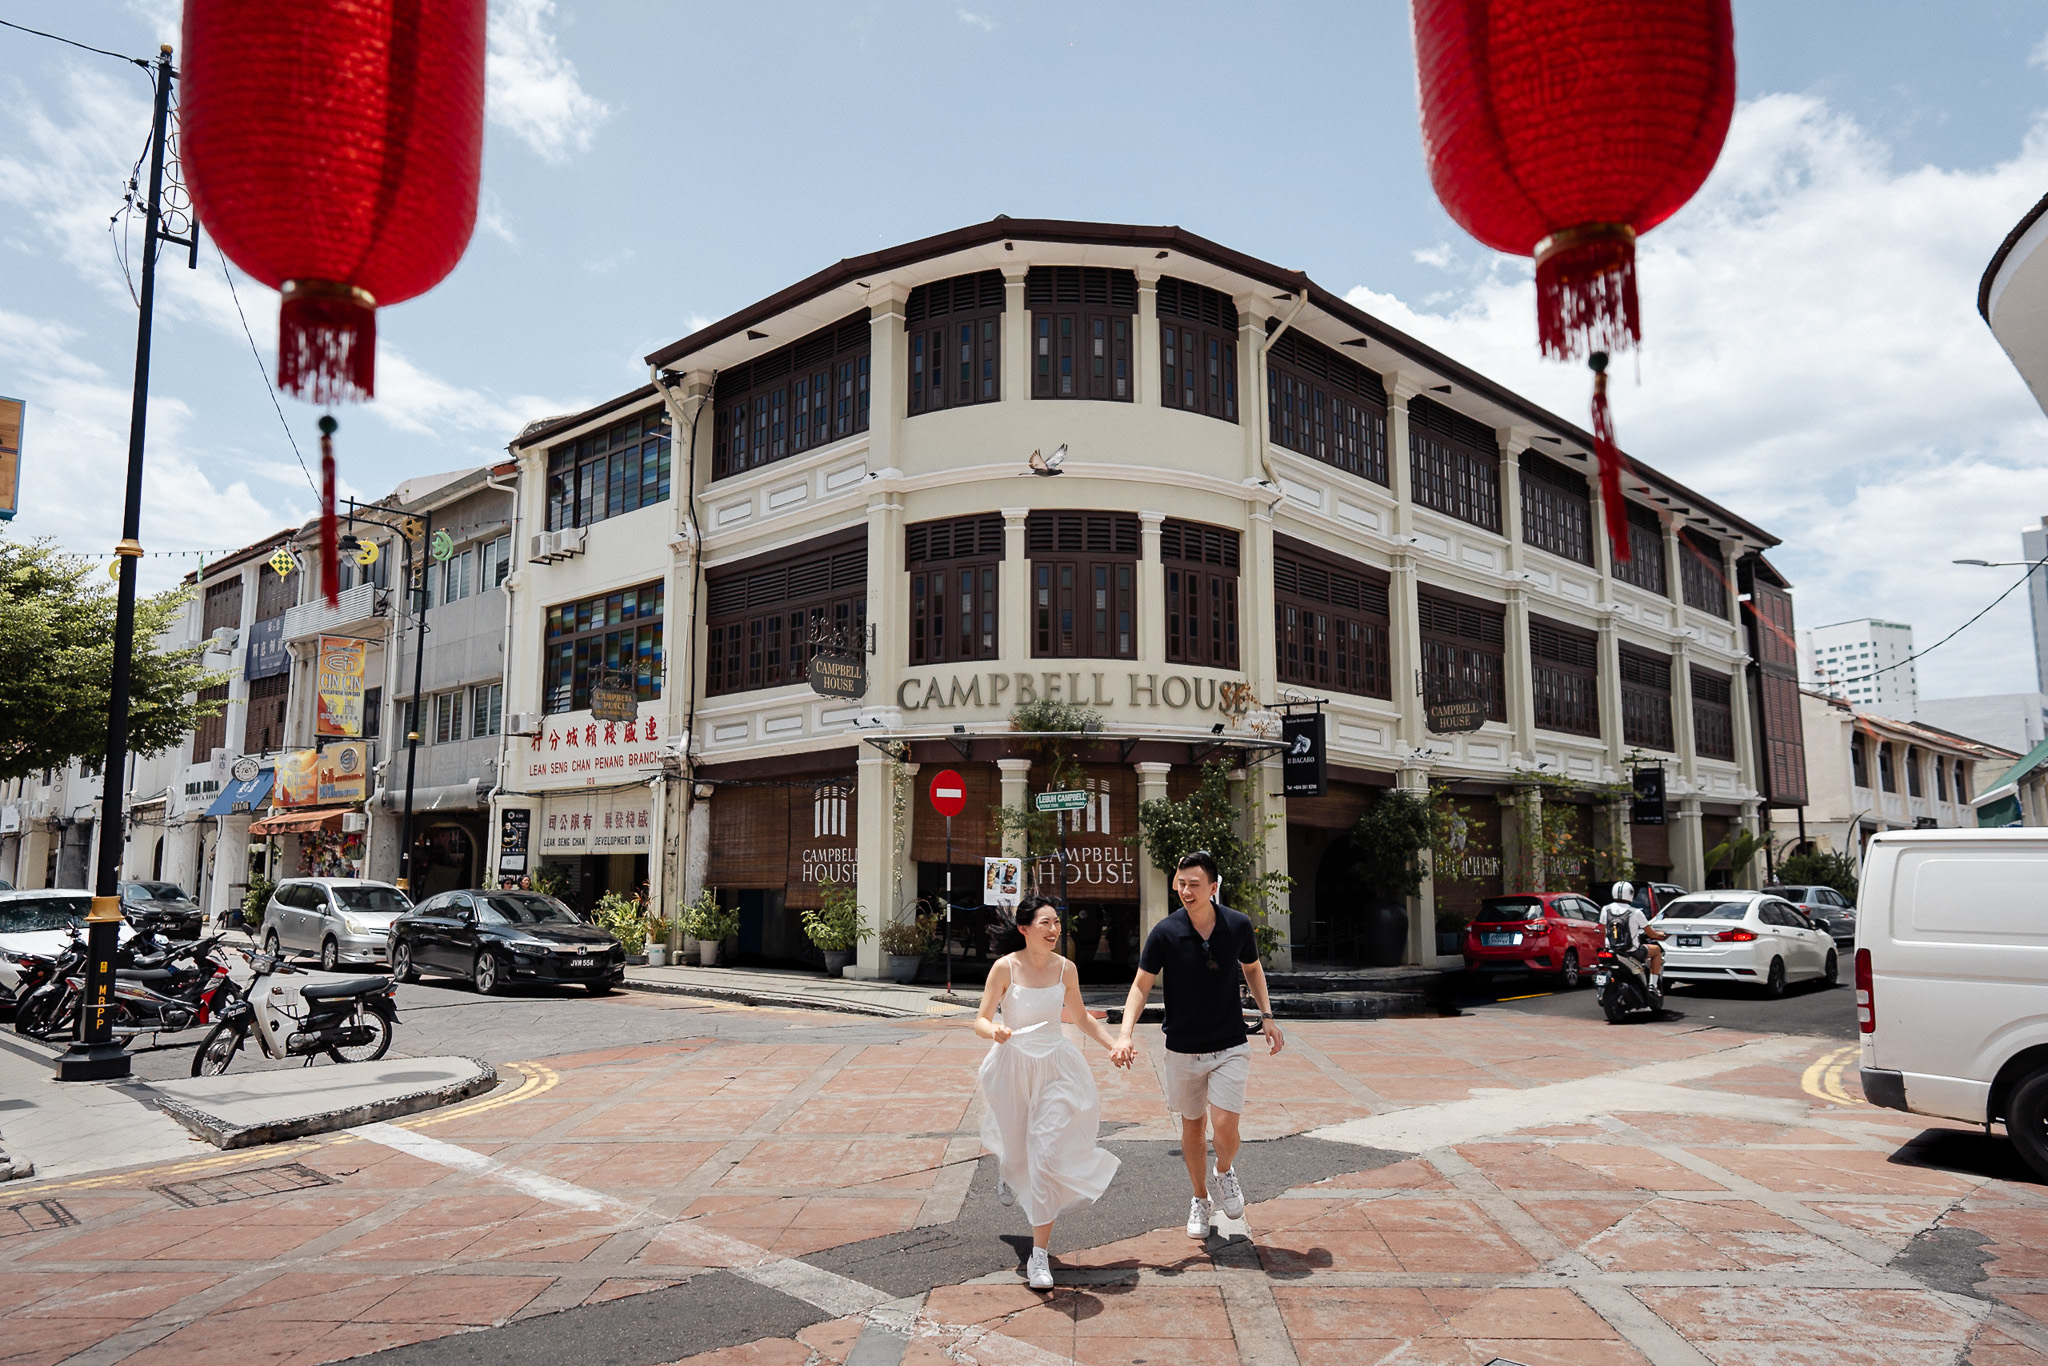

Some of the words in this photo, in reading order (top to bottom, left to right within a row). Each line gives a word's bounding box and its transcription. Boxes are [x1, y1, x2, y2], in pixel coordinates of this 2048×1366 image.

[815, 660, 862, 679] CAMPBELL
[320, 673, 339, 689] CIN
[342, 675, 362, 691] CIN
[823, 676, 854, 692] HOUSE
[897, 672, 1114, 711] CAMPBELL
[1127, 672, 1249, 715] HOUSE
[1431, 703, 1479, 717] CAMPBELL
[1440, 715, 1471, 728] HOUSE
[529, 764, 547, 776] LEAN
[550, 761, 568, 774] SENG
[571, 759, 591, 772] CHAN
[594, 754, 624, 769] PENANG
[628, 750, 660, 766] BRANCH
[1057, 792, 1086, 802] CAMPBELL
[543, 838, 555, 847] LEAN
[557, 837, 570, 846] SENG
[572, 837, 585, 846] CHAN
[594, 836, 631, 846] DEVELOPMENT
